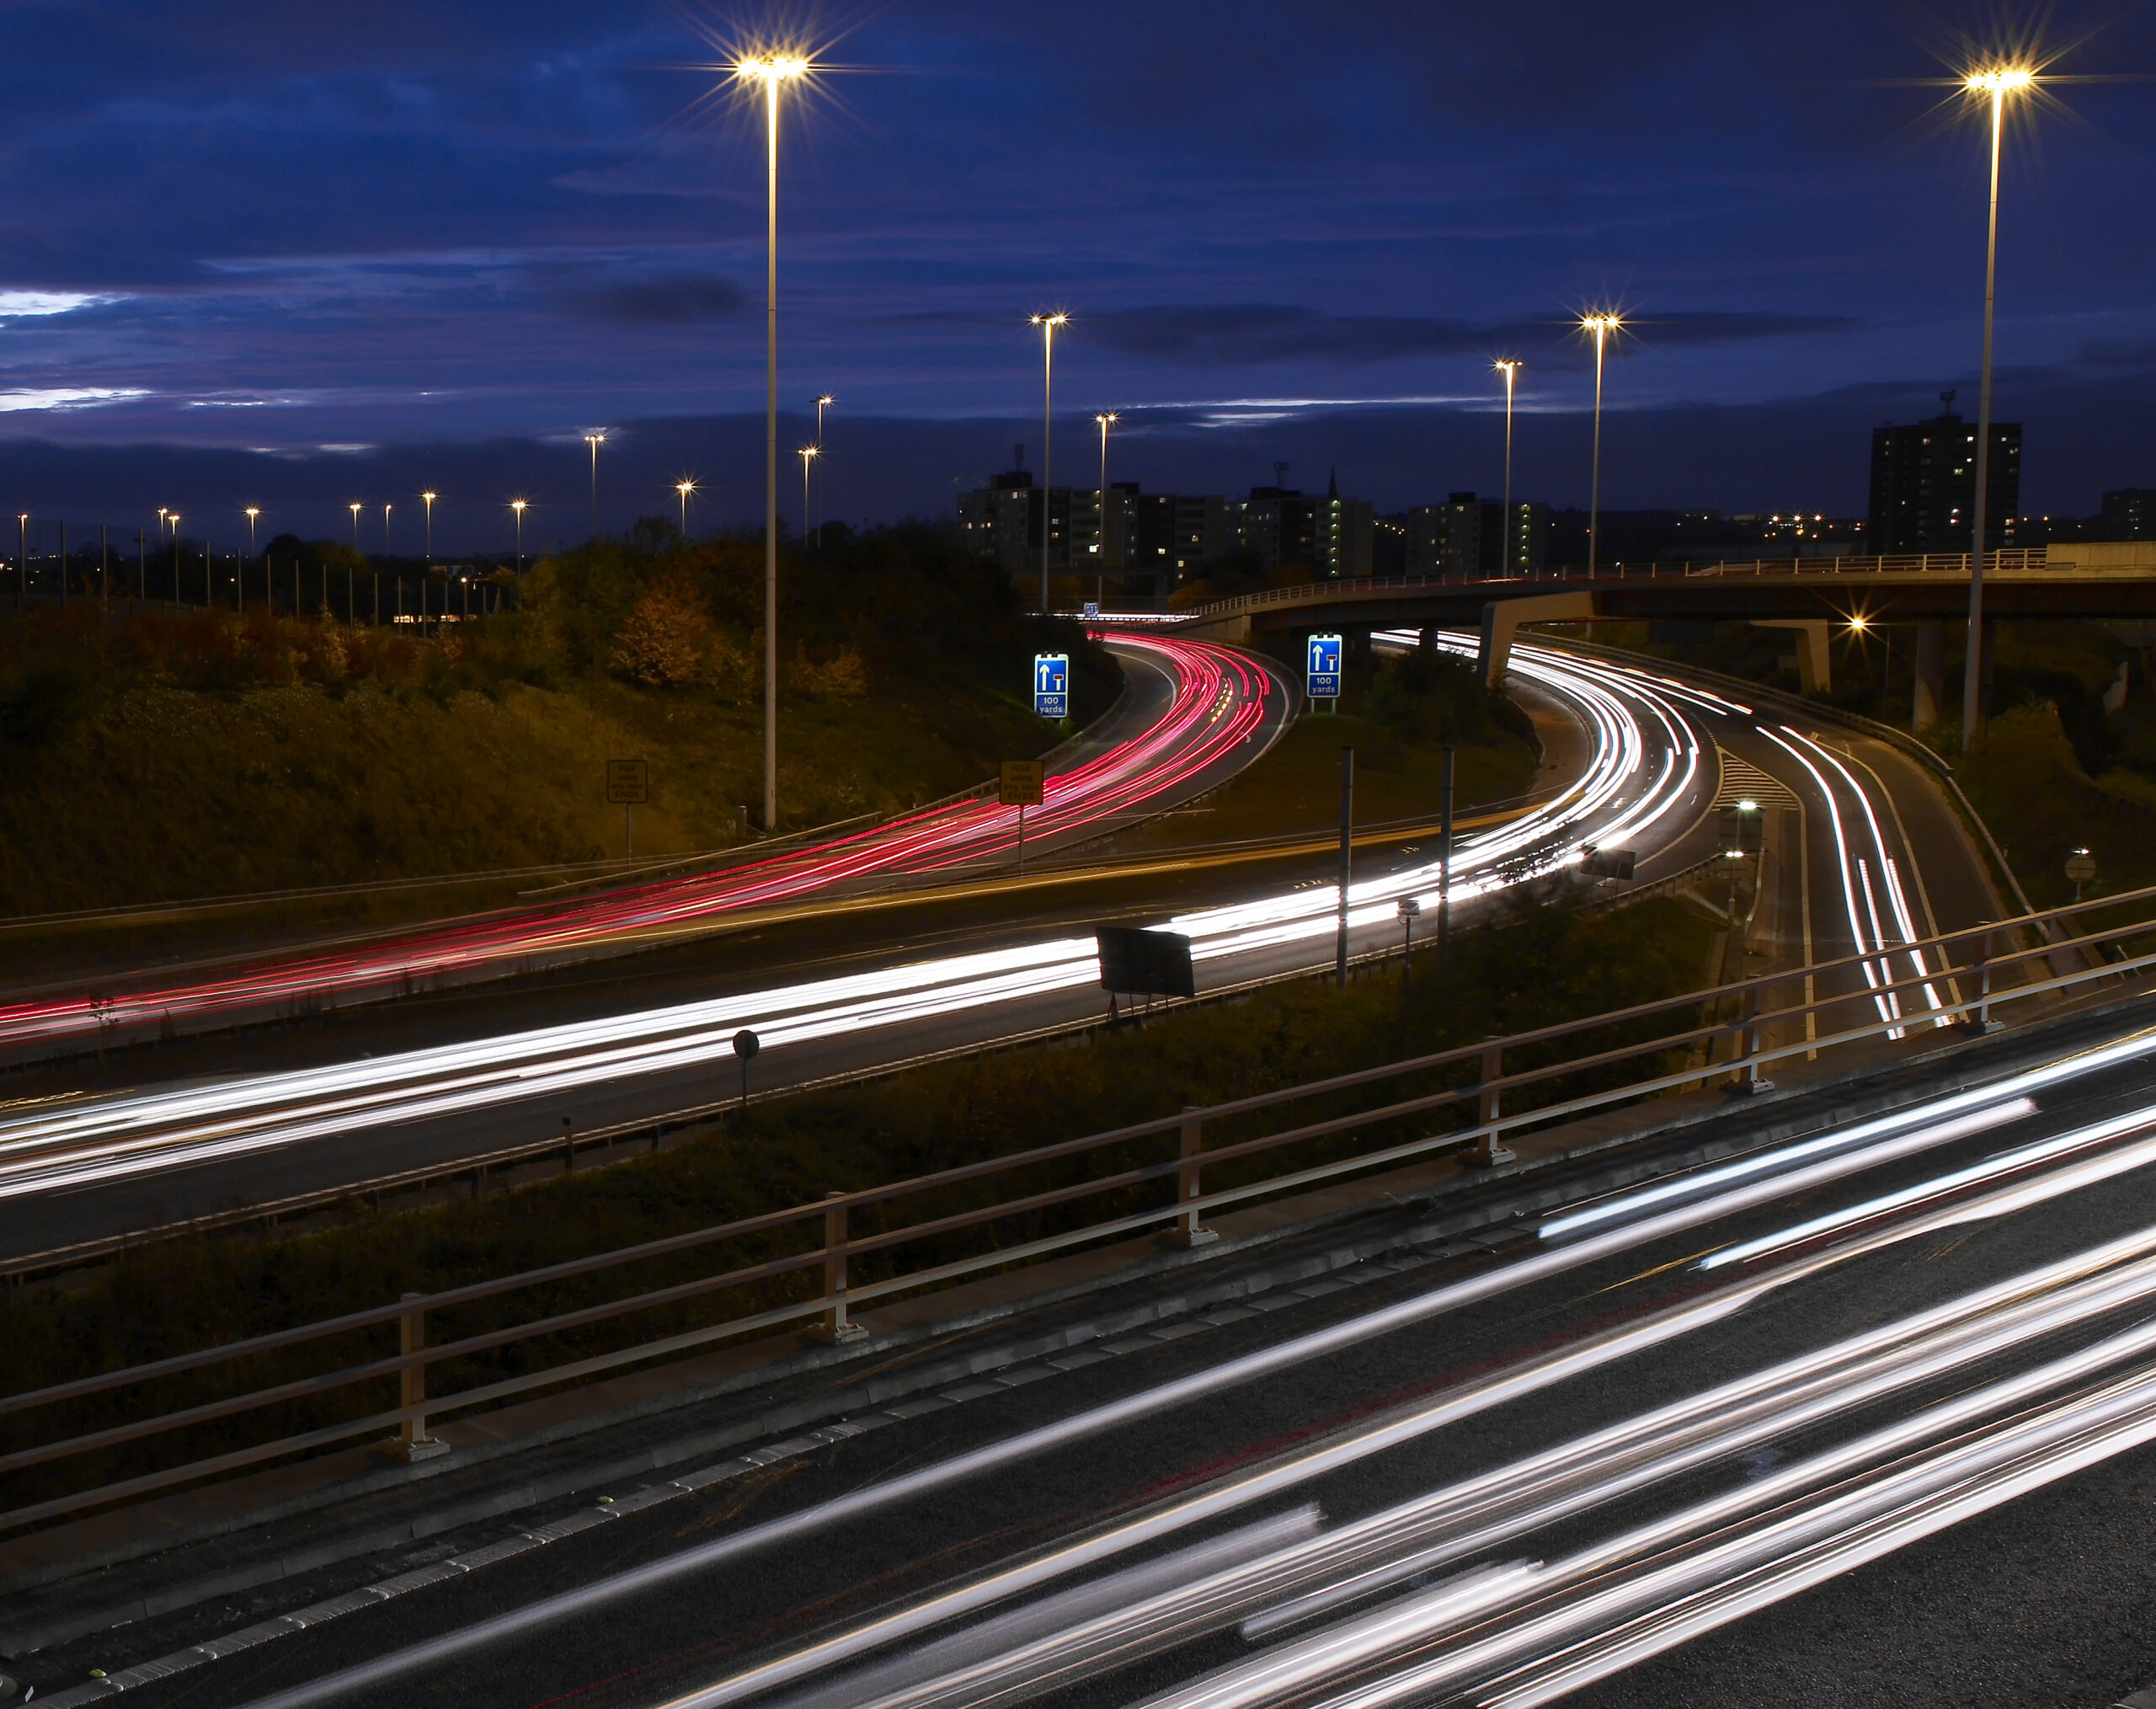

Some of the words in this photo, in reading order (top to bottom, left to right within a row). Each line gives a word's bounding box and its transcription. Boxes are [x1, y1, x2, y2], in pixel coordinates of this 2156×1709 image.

[1312, 686, 1336, 694] yards
[1039, 706, 1063, 714] yards
[1011, 764, 1031, 772] HGV
